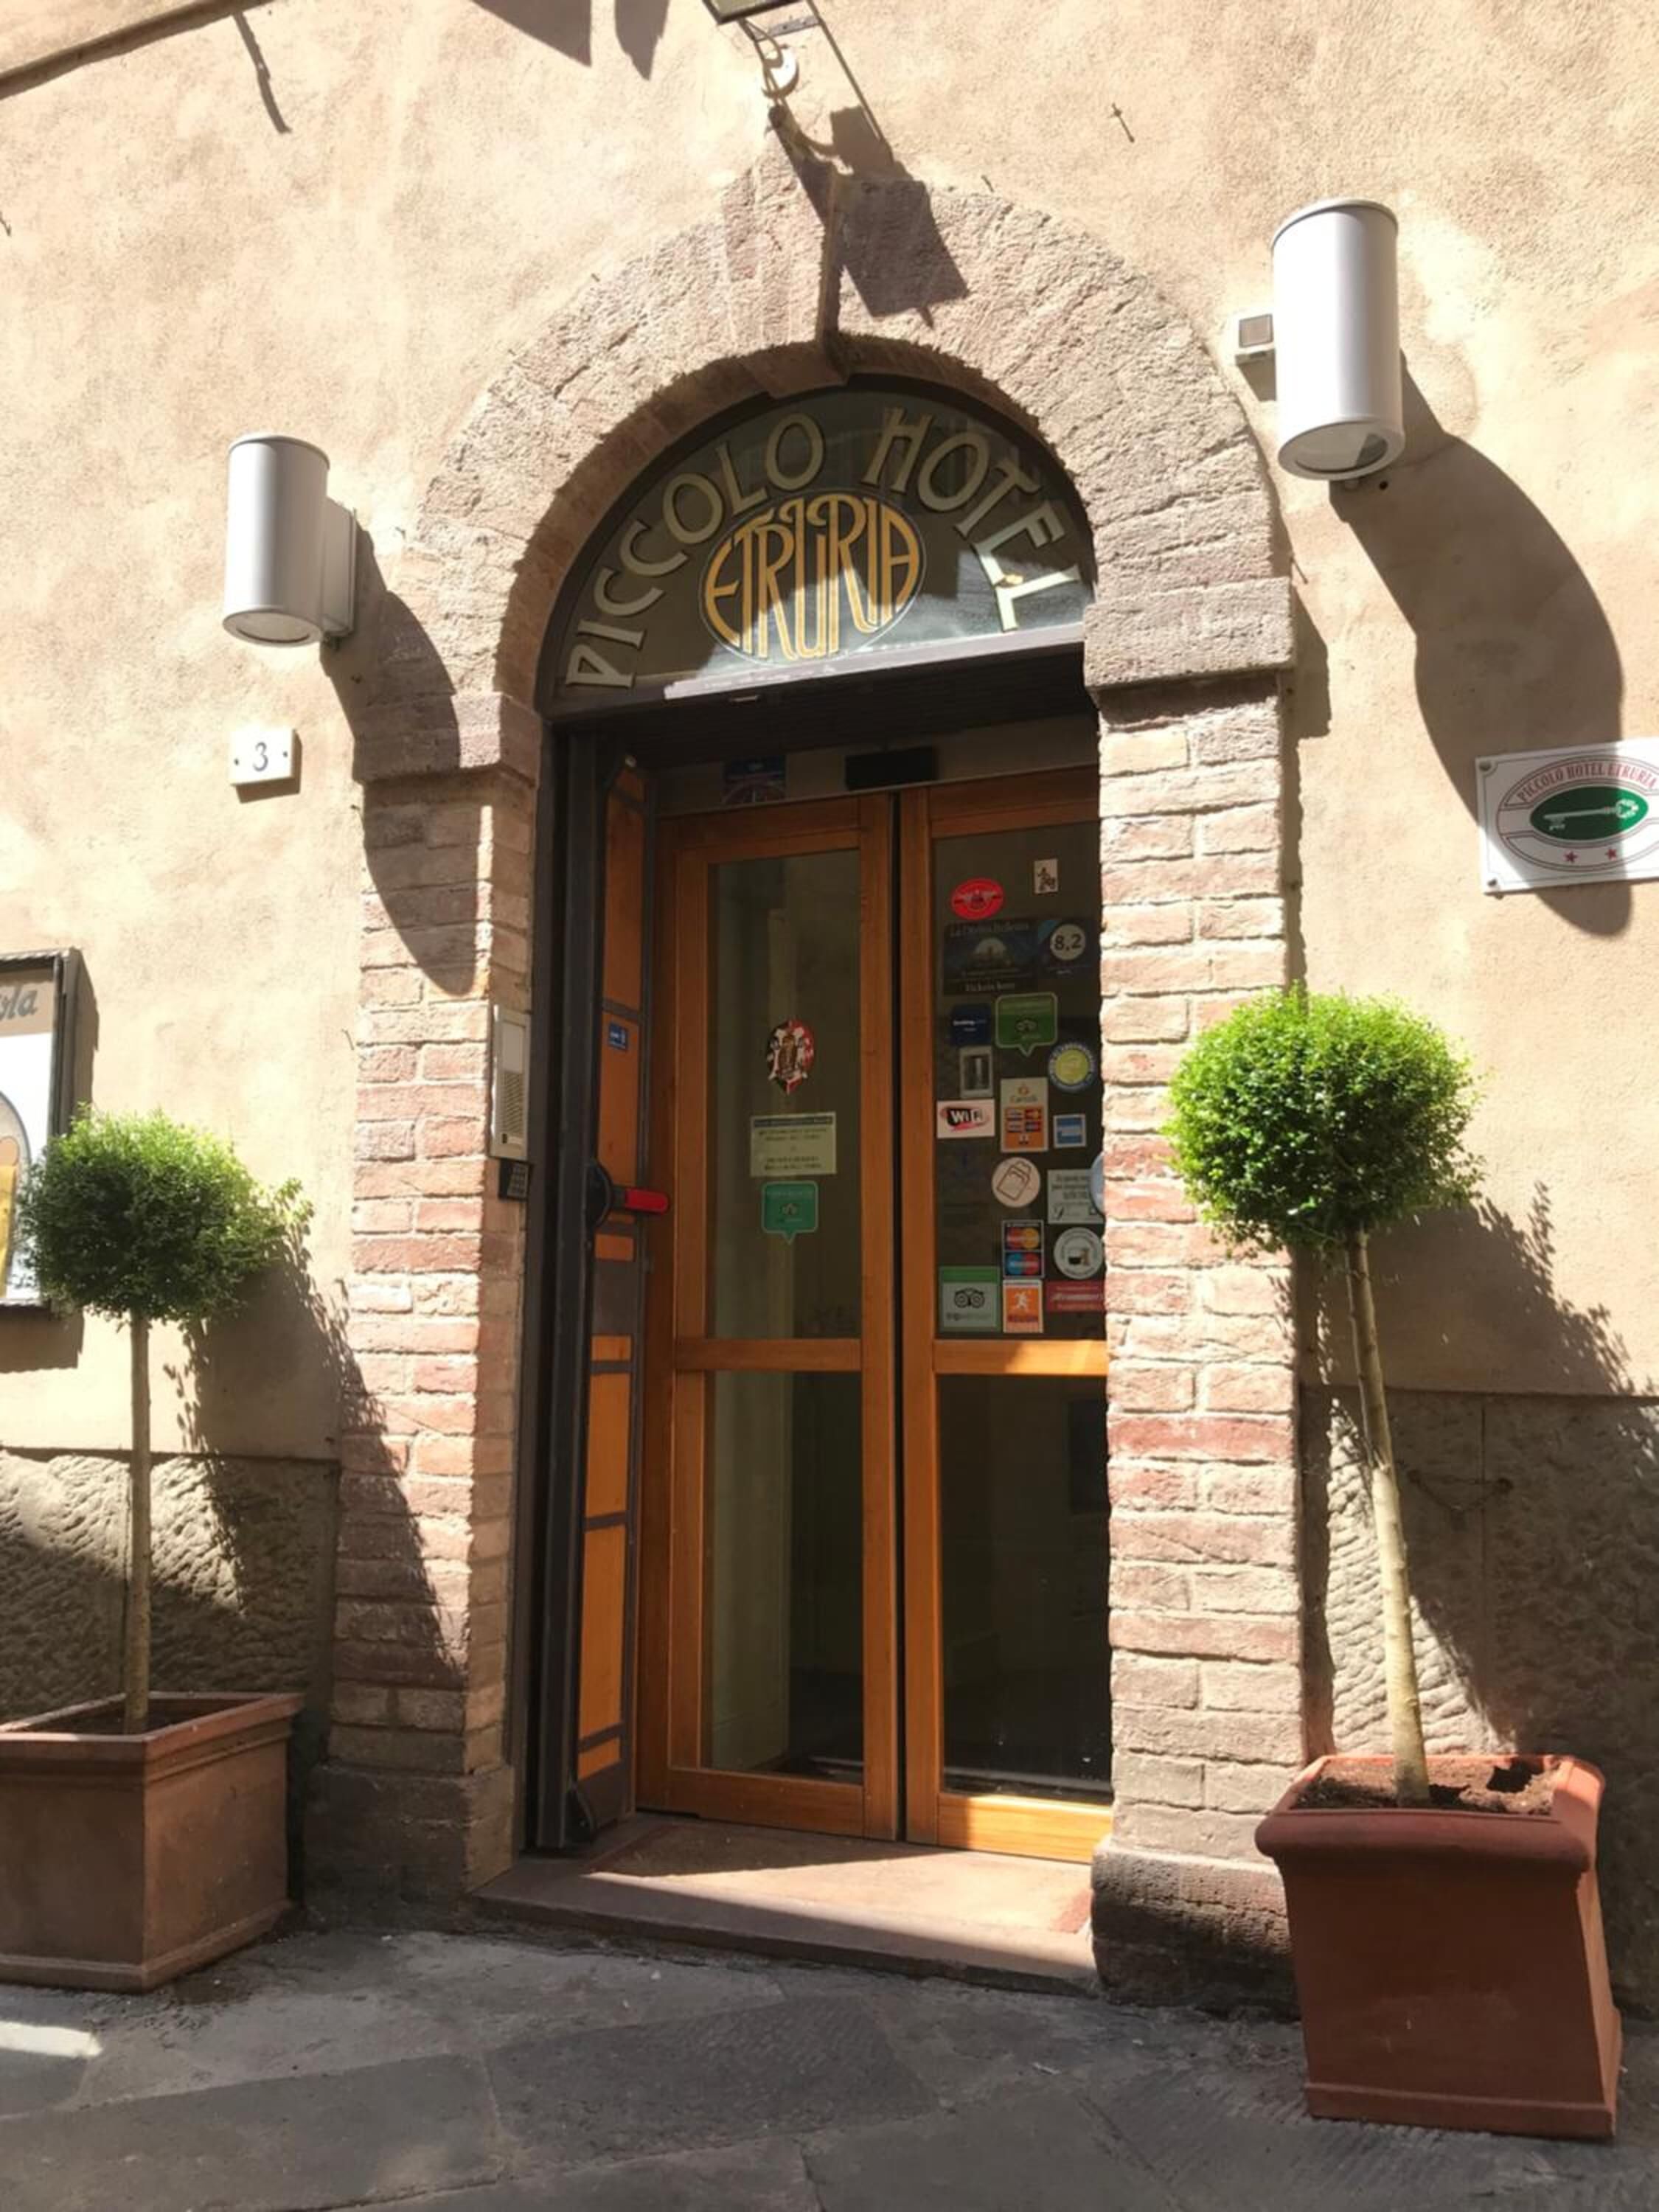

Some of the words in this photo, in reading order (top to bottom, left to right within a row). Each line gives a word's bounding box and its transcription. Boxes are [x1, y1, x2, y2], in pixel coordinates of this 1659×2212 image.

[566, 412, 824, 689] PICCOLO
[861, 407, 1080, 632] HOTEL
[704, 494, 921, 660] ETRURIA
[252, 741, 268, 772] 3
[1516, 767, 1564, 803] PICCOLO
[1566, 762, 1605, 779] HOTEL
[1606, 763, 1657, 788] ETRURIA
